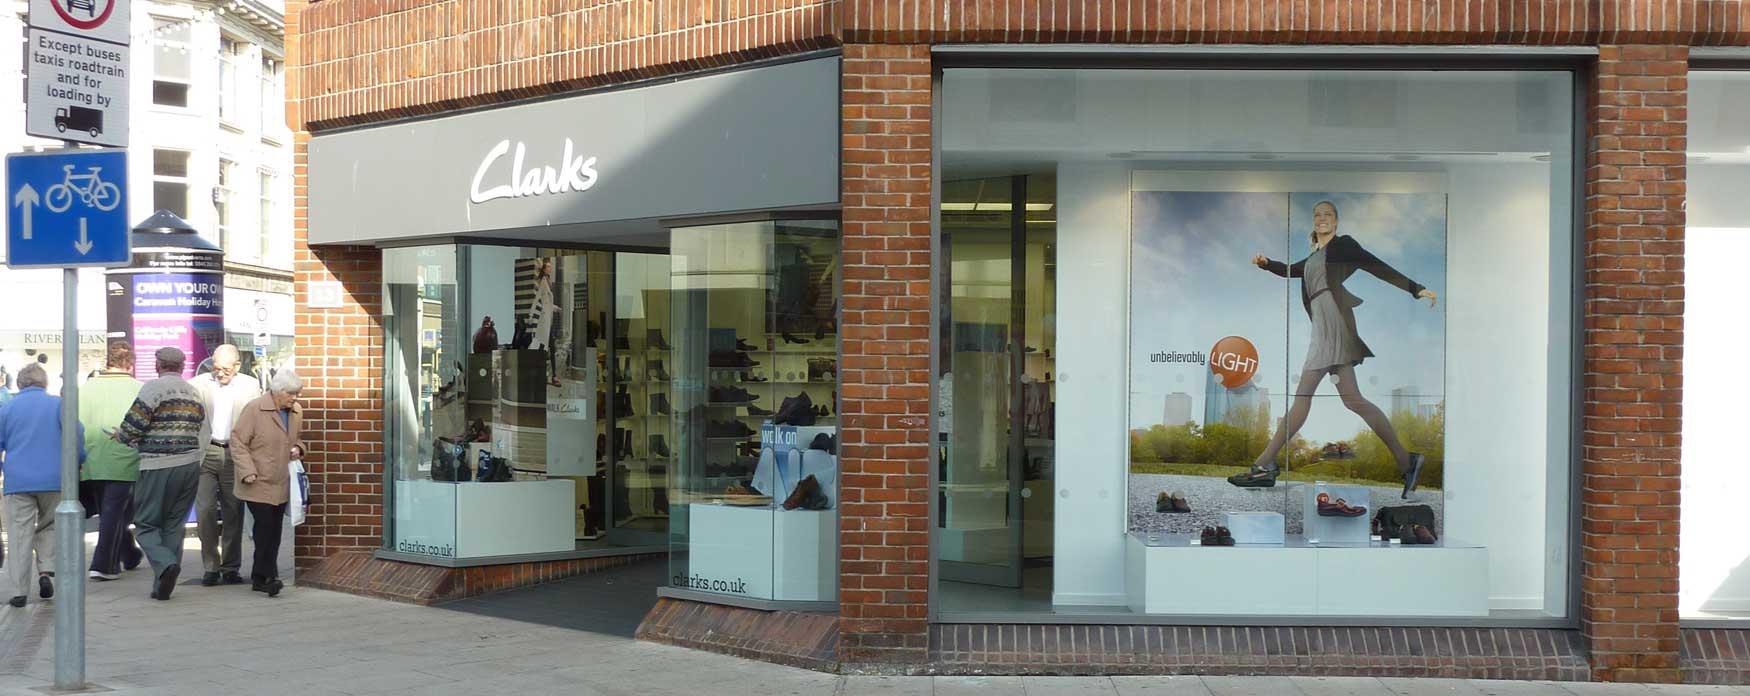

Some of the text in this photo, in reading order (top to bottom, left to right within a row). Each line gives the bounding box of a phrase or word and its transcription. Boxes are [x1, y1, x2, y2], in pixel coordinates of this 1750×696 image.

[39, 36, 121, 62] Except buses
[34, 51, 125, 78] taxis roadtrain
[57, 73, 102, 88] and for
[47, 85, 111, 107] loading by
[470, 137, 598, 204] Clarks
[136, 282, 173, 294] OWN
[174, 282, 209, 294] YOUR
[177, 297, 211, 308] Holiday
[24, 333, 62, 344] RIVER
[80, 334, 105, 344] LAN
[1150, 351, 1257, 373] unbelievably LIGHT
[785, 431, 797, 445] on
[399, 539, 453, 557] clarks.co.uk
[672, 572, 747, 594] clarks.co.uk
